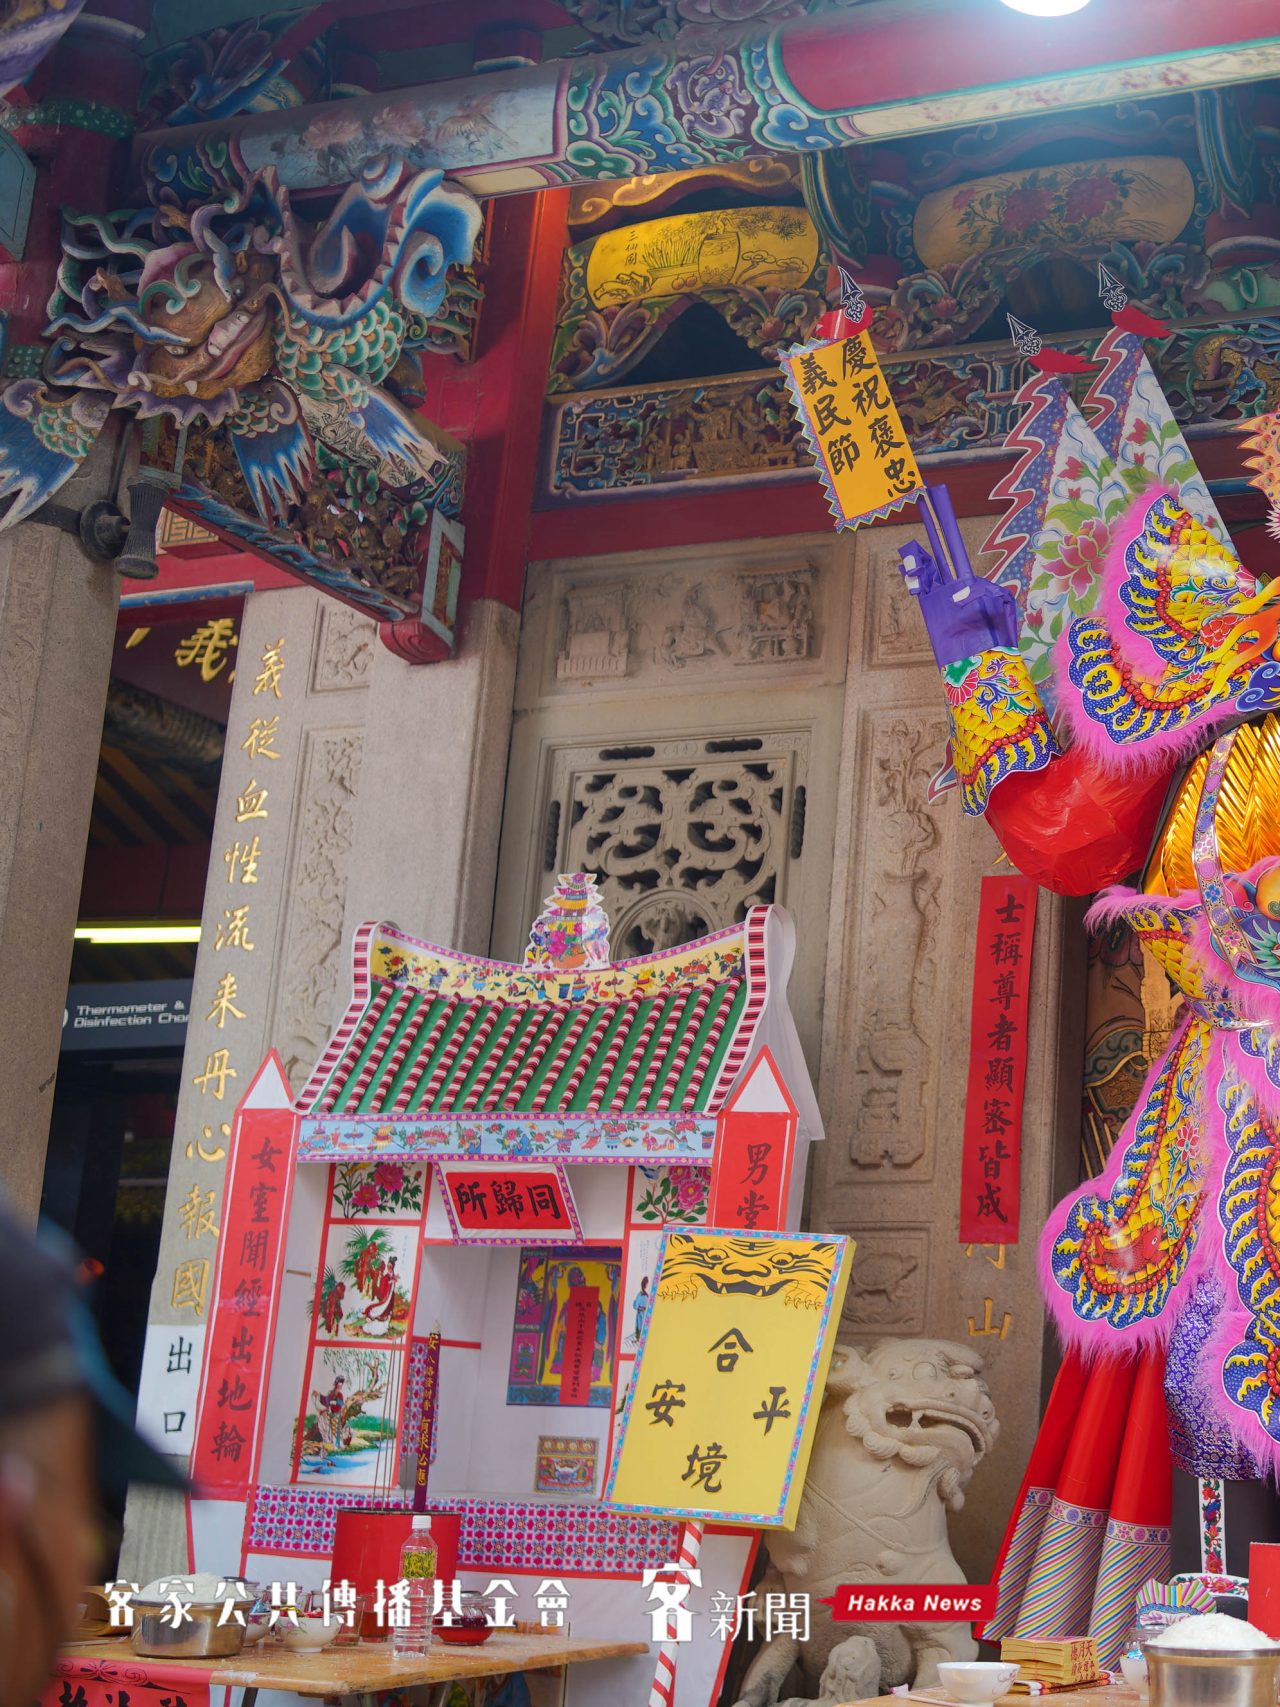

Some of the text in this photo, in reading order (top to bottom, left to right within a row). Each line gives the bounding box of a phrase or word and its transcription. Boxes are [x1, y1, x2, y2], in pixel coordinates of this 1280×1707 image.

[799, 352, 861, 476] 義民節
[842, 335, 916, 498] 慶祝褒忠
[74, 1014, 152, 1029] Disinfection
[76, 999, 185, 1017] Thermometer &
[164, 1335, 194, 1435] 出口
